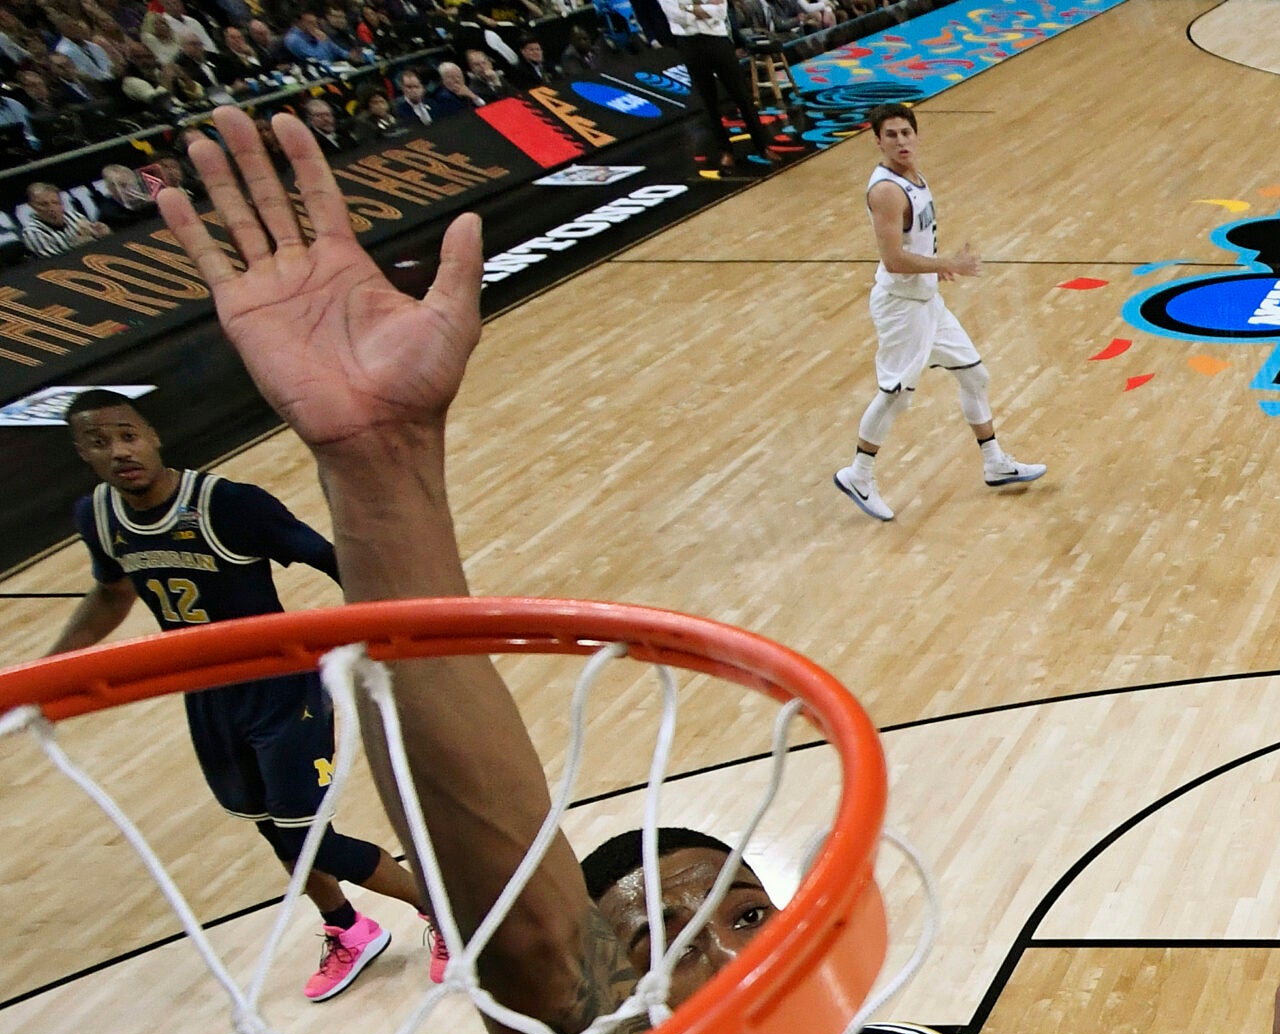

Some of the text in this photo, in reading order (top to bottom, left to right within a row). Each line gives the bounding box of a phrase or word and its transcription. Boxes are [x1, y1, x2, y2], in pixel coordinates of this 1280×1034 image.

[333, 138, 510, 206] HERE
[482, 184, 689, 290] NTONIO
[145, 577, 211, 622] 12
